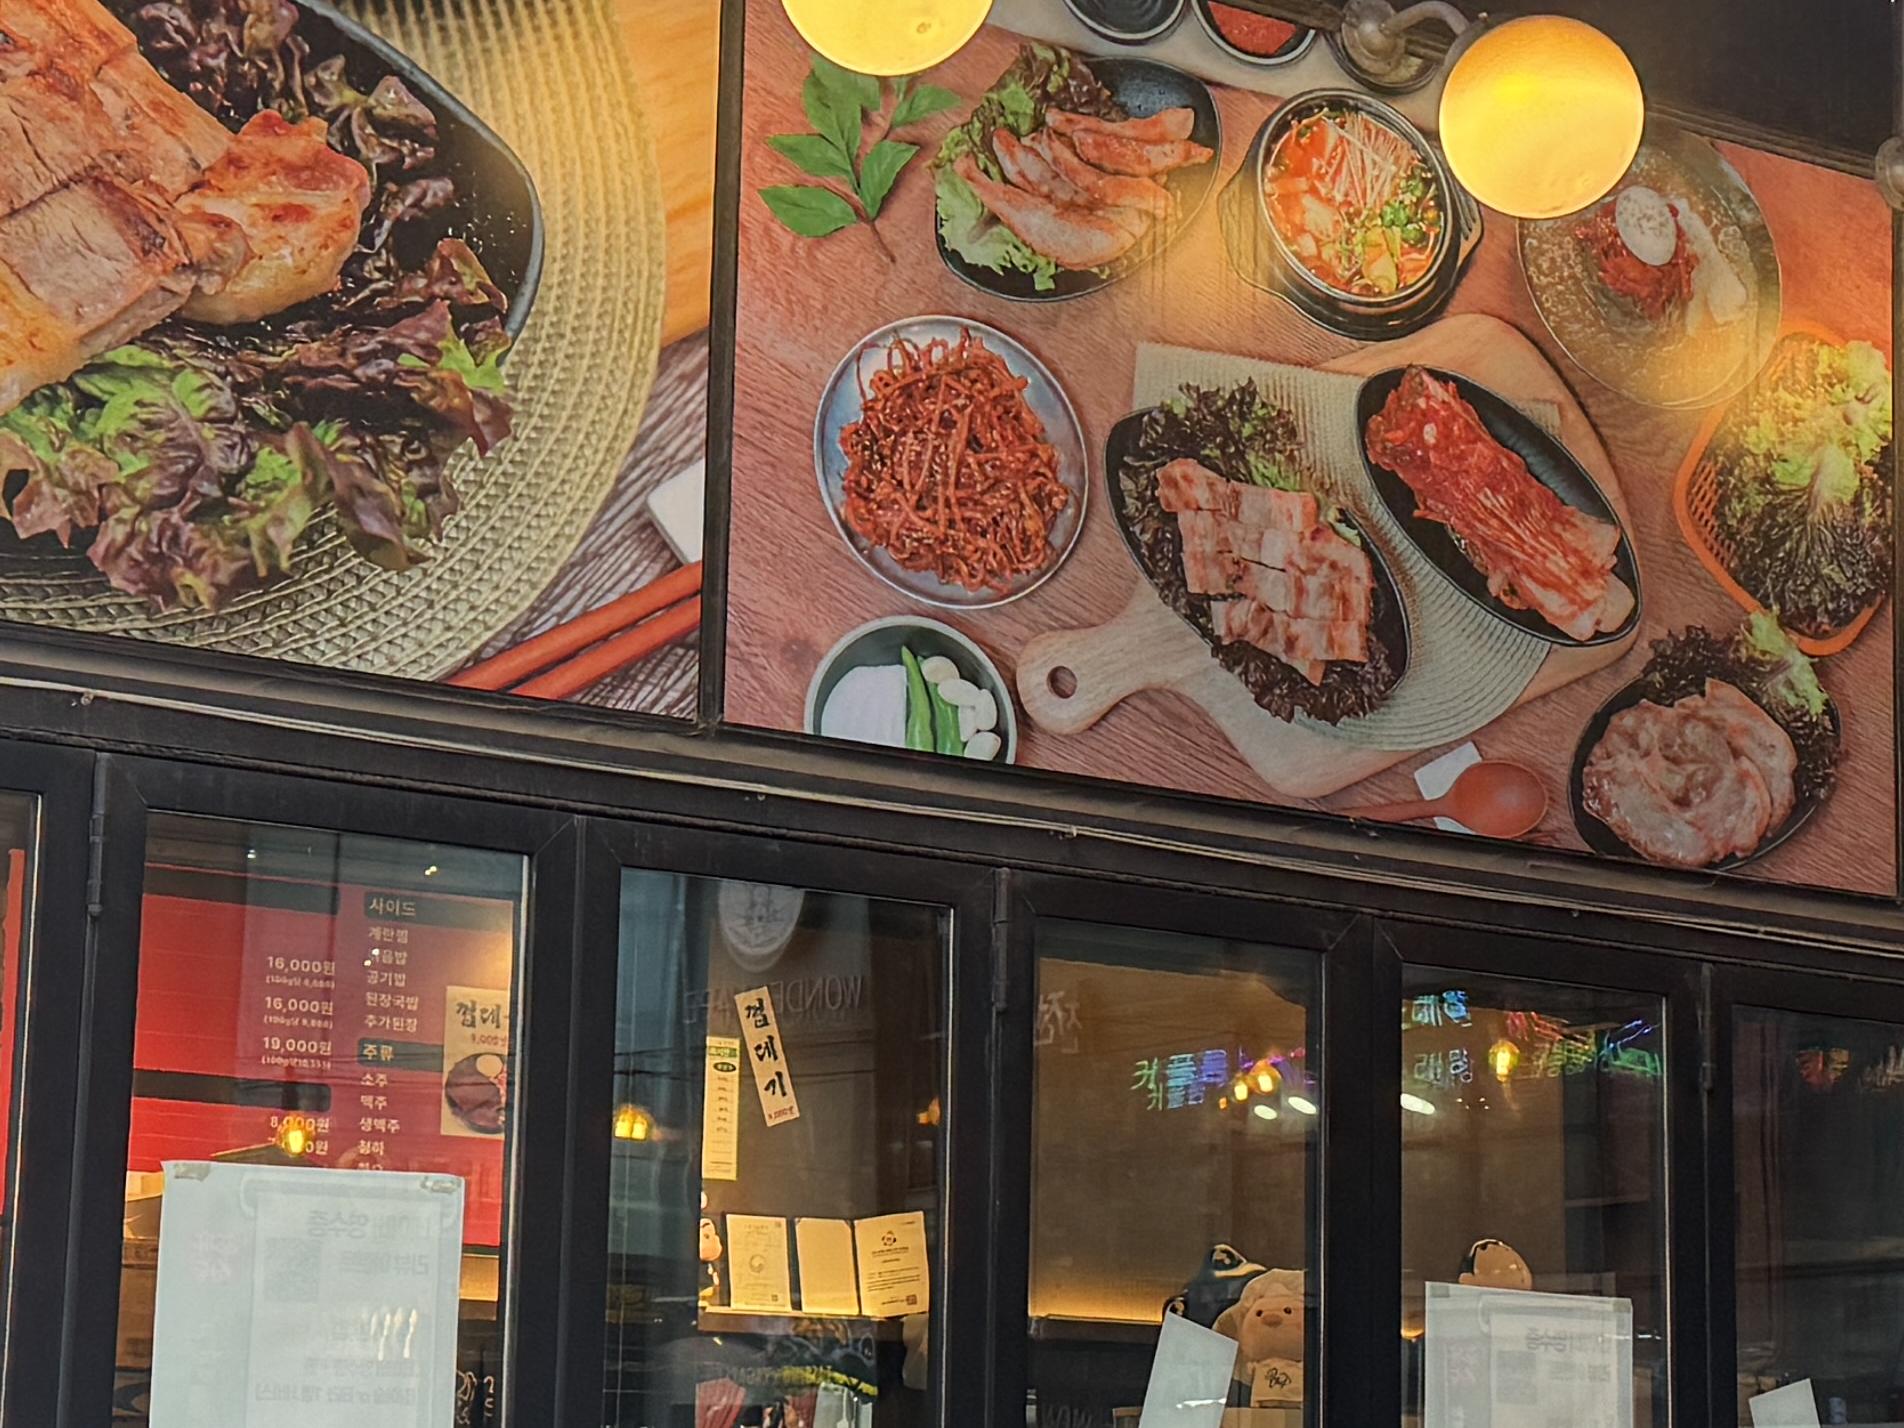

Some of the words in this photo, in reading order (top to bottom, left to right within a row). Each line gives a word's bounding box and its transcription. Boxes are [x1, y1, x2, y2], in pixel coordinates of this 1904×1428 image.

[369, 898, 416, 917] 사이드
[267, 956, 336, 976] 16,000원
[264, 996, 333, 1016] 16,000원
[455, 1000, 510, 1029] 껍데
[744, 997, 788, 1098] 껍데기
